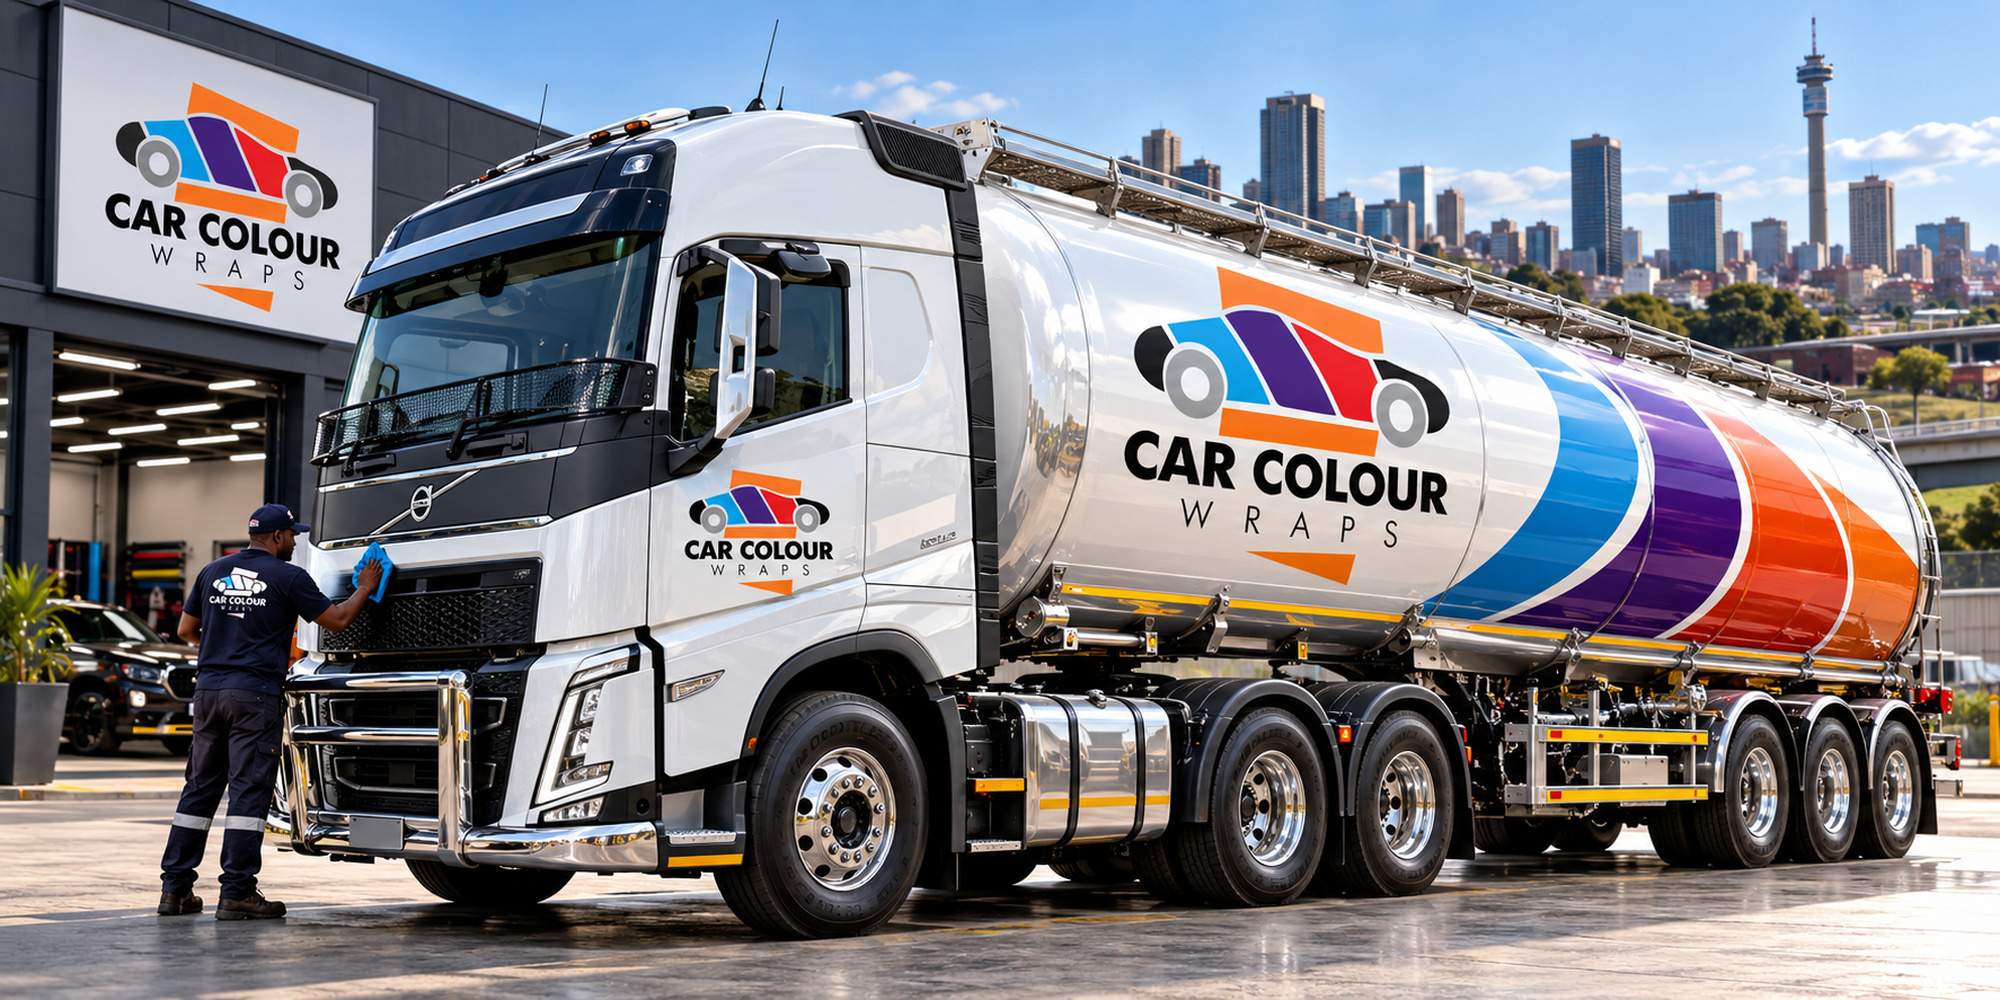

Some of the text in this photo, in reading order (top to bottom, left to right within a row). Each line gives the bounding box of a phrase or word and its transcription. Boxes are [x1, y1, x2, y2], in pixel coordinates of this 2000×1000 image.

[105, 193, 341, 270] CAR COLOUR
[151, 244, 304, 290] WRAPS
[1124, 430, 1448, 515] CAR COLOUR
[1181, 498, 1398, 548] WRAPS
[685, 540, 834, 560] CAR COLOUR
[711, 564, 810, 576] WRAPS
[209, 596, 267, 606] CAR COLOUR
